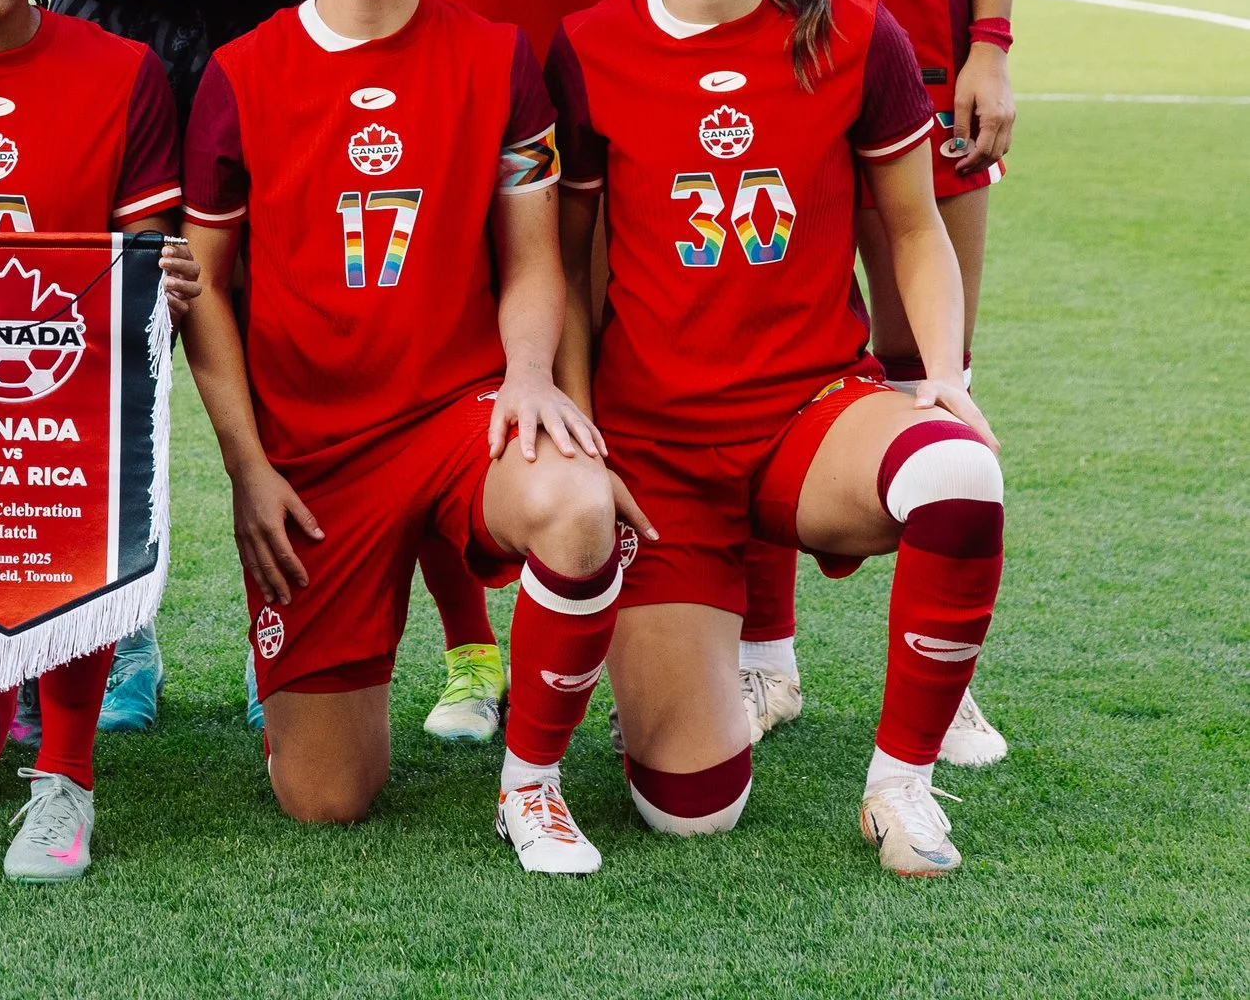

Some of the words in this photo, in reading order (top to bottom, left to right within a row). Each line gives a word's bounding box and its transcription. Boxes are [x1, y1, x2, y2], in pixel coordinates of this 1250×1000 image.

[702, 128, 751, 139] CANADA
[351, 145, 400, 156] CANADA
[670, 167, 797, 268] 30
[336, 188, 424, 288] 17
[27, 466, 88, 487] RICA
[22, 552, 52, 565] 2025
[24, 570, 73, 583] Toronto
[257, 625, 282, 640] CANADA
